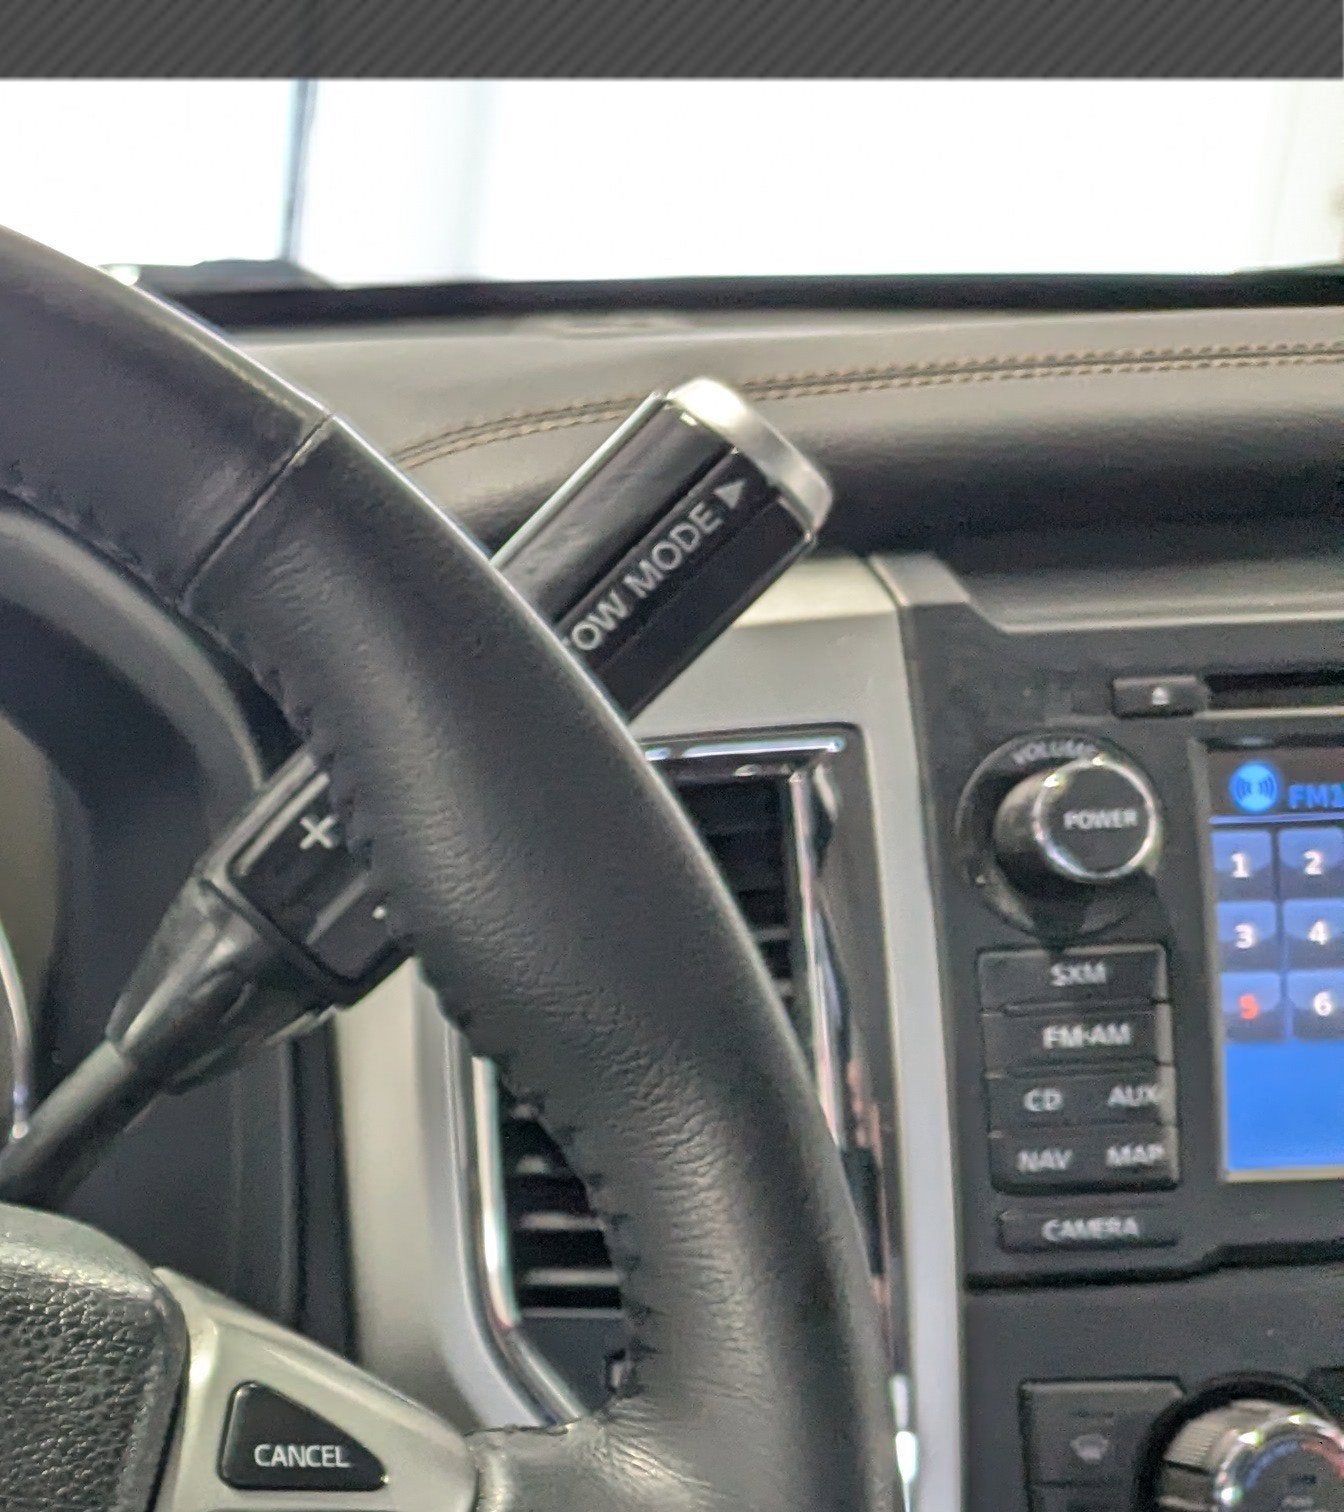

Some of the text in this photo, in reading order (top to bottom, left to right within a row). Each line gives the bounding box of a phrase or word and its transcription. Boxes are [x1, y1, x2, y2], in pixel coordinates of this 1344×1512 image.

[566, 502, 724, 651] OW MODE
[1063, 808, 1138, 829] POWER
[1230, 853, 1250, 878] 1
[1303, 849, 1324, 876] 2
[1234, 924, 1257, 949] 3
[1309, 921, 1331, 946] 4
[1050, 961, 1108, 986] SXM
[1238, 993, 1260, 1020] 5
[1313, 991, 1334, 1018] 6
[1023, 1087, 1064, 1112] CD
[1108, 1086, 1162, 1107] AUX
[1017, 1148, 1073, 1172] NAV
[1106, 1143, 1165, 1167] MAP
[1042, 1216, 1141, 1242] CAMERA
[253, 1443, 353, 1469] CANCEL
